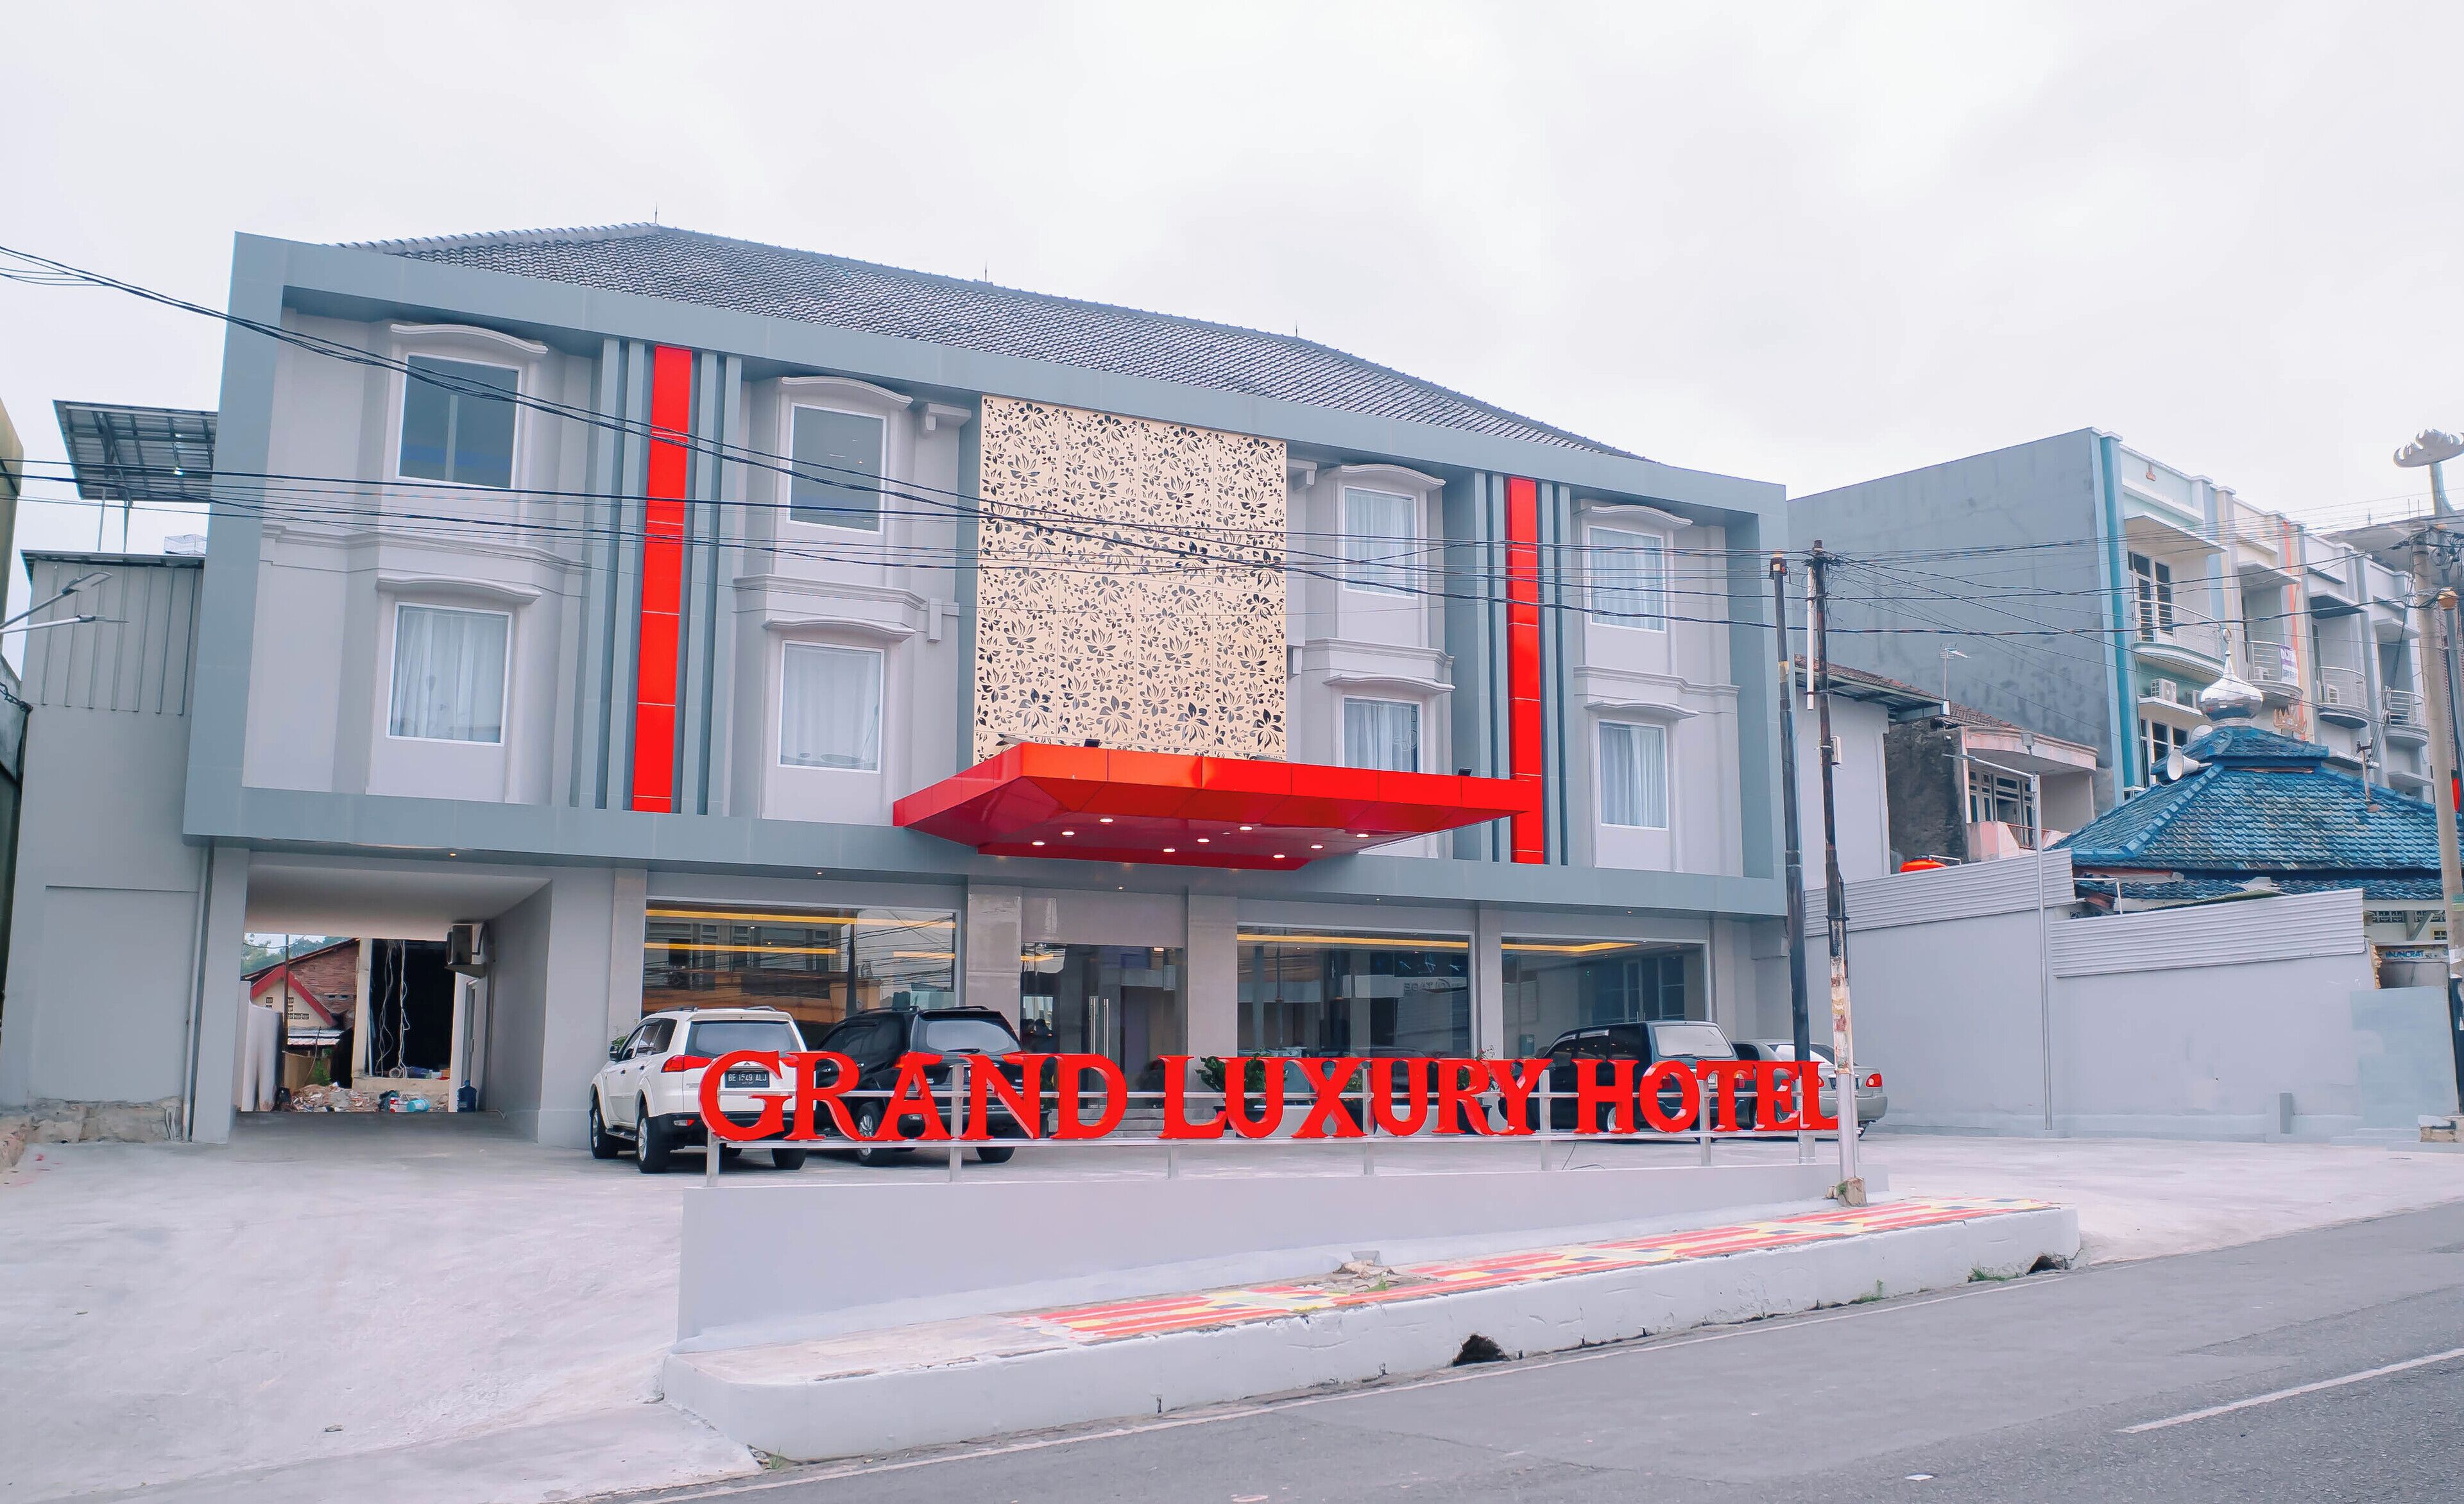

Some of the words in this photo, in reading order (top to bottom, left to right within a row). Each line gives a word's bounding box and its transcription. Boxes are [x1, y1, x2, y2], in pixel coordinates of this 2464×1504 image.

[699, 1050, 1127, 1141] GRAND
[1157, 1055, 1552, 1139] LUXURY
[1572, 1059, 1839, 1134] HOTEL
